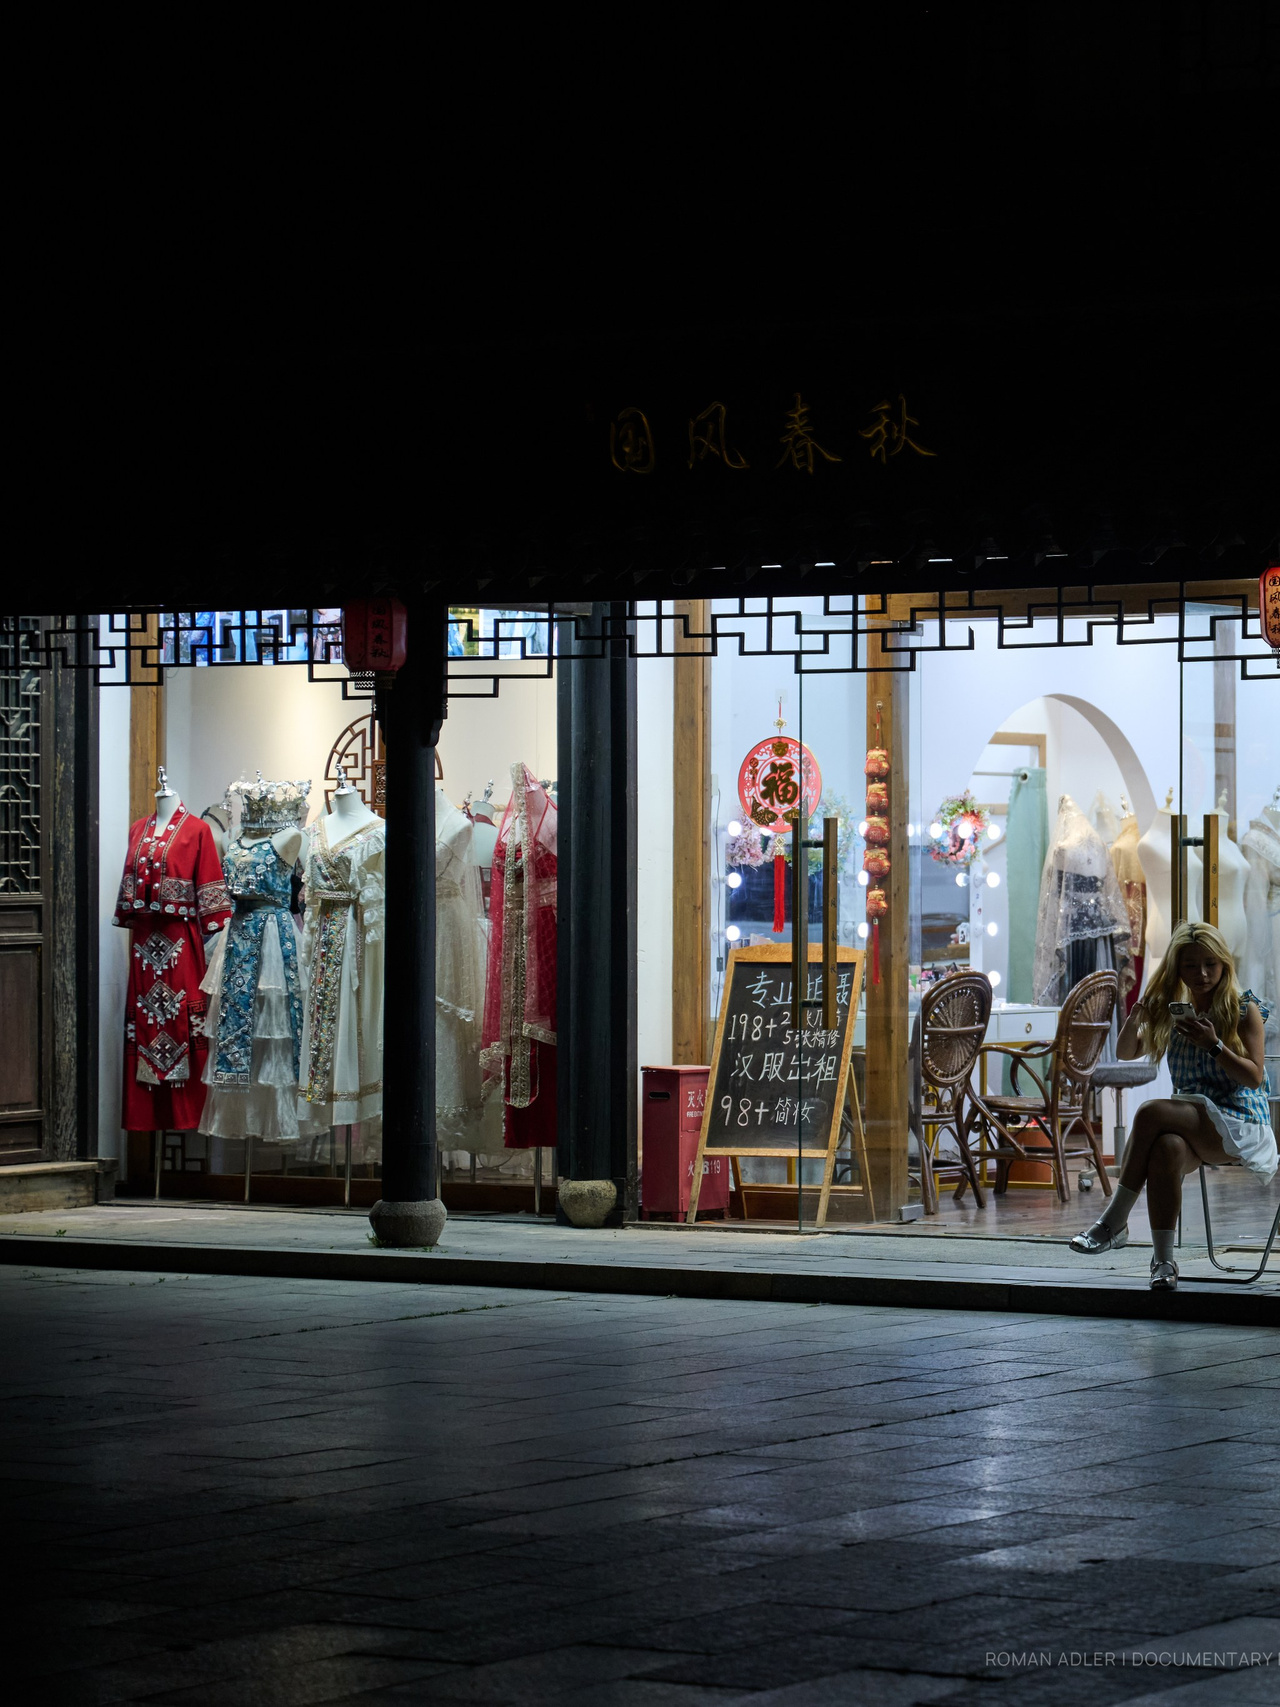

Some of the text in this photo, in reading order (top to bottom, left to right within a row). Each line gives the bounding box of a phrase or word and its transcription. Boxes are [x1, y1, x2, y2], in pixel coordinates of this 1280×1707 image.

[608, 392, 938, 475] 国风春秋
[760, 762, 798, 807] 福
[731, 1052, 838, 1090] 汉服出租
[687, 1089, 708, 1108] 灭火
